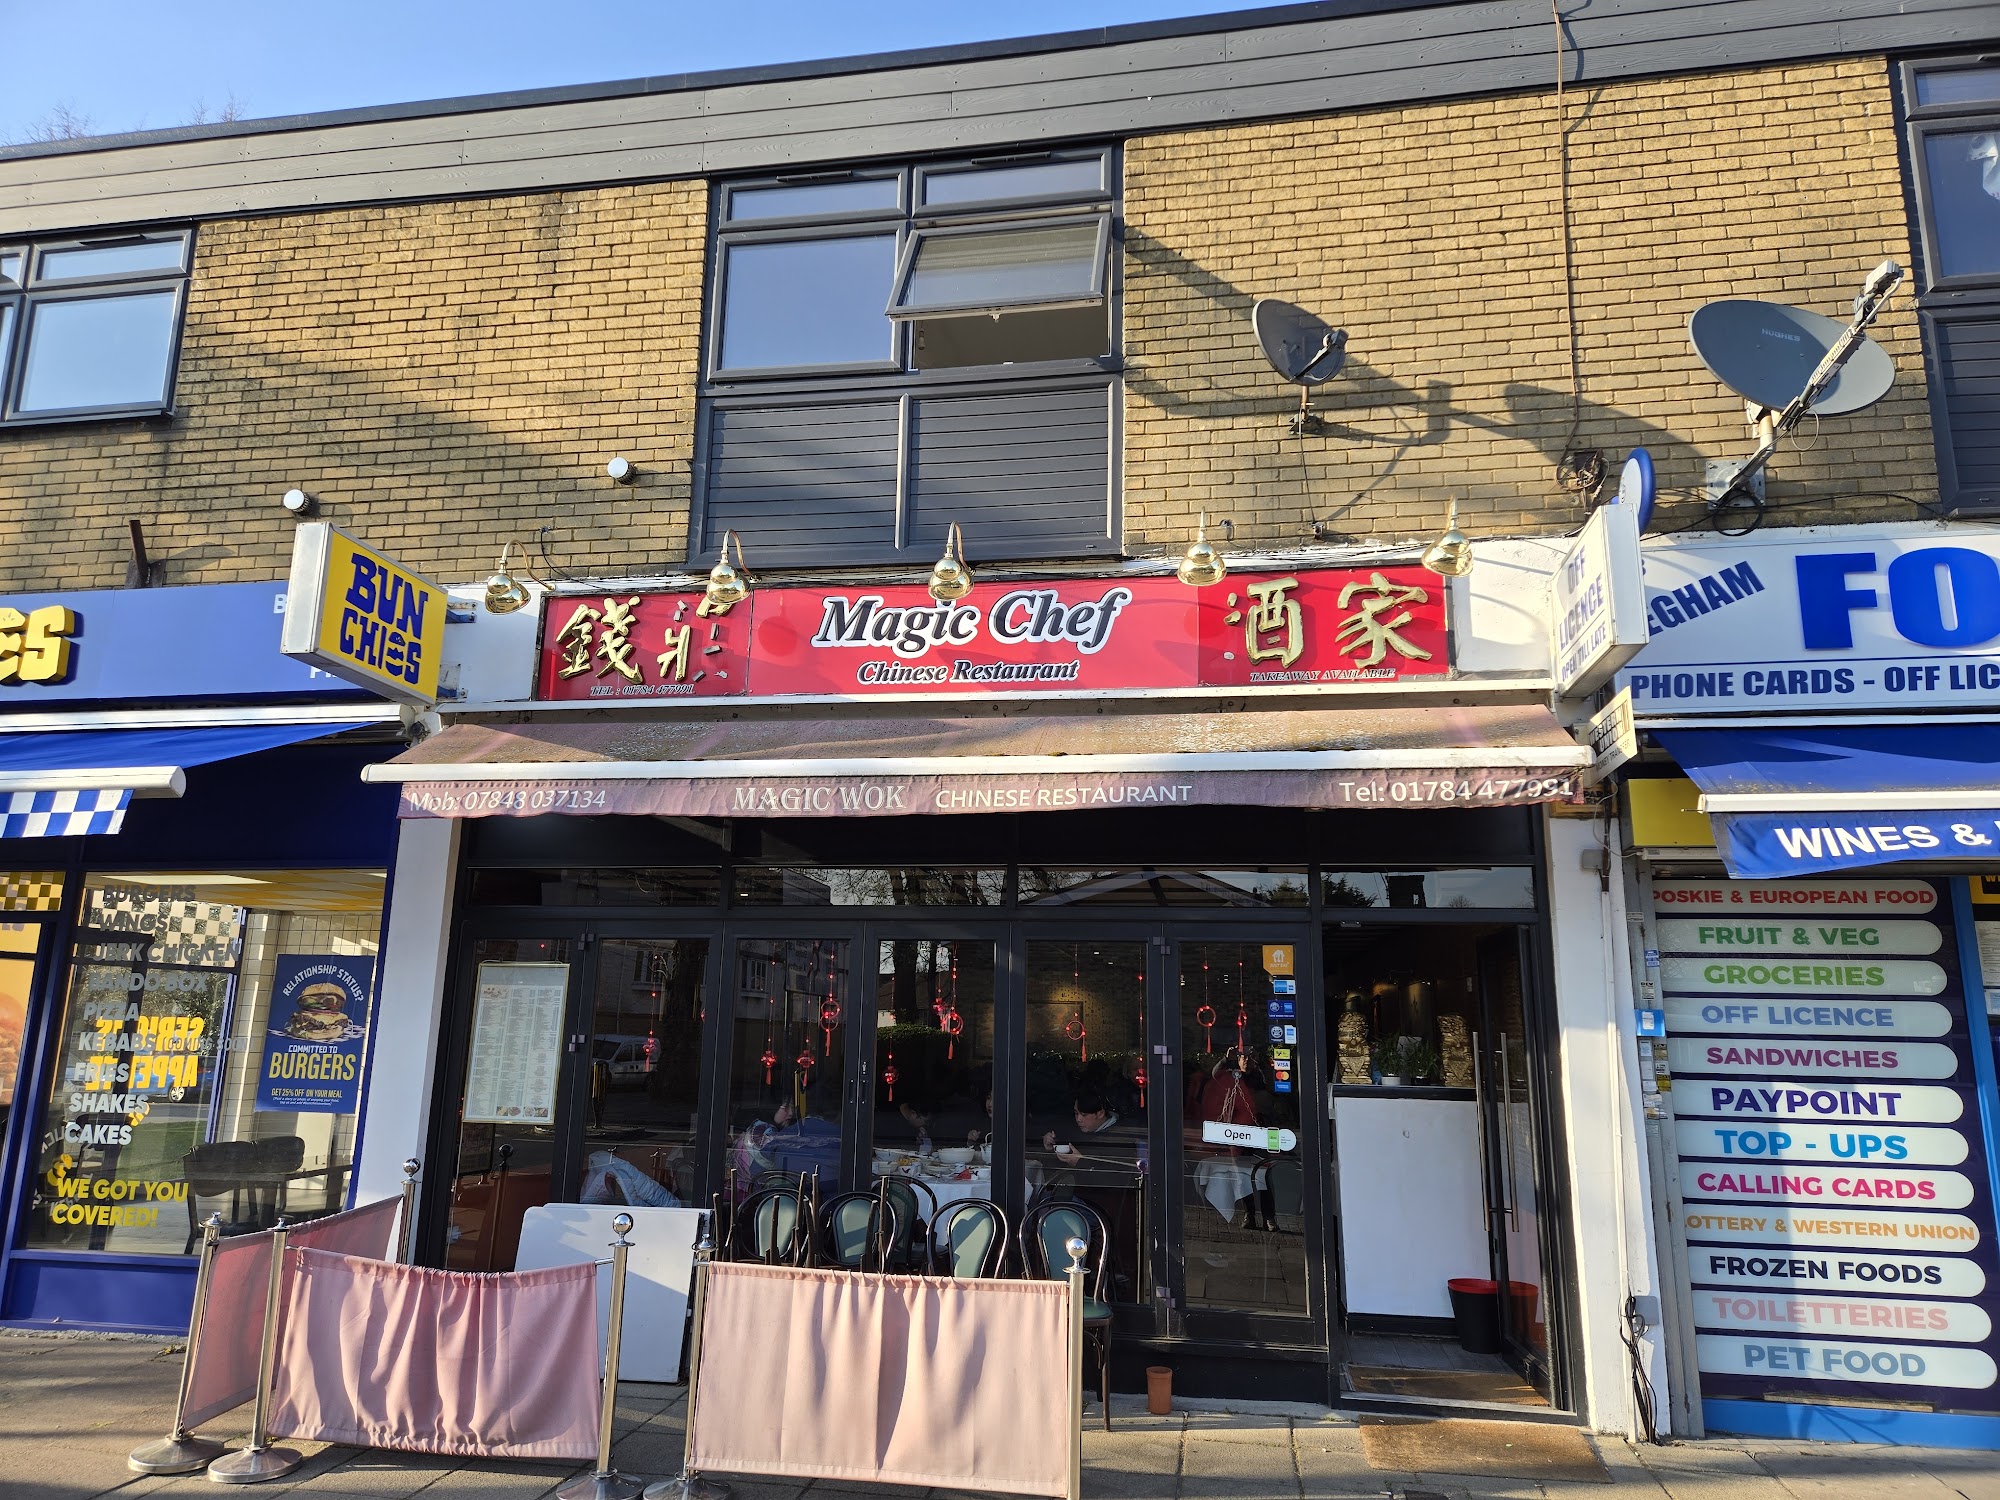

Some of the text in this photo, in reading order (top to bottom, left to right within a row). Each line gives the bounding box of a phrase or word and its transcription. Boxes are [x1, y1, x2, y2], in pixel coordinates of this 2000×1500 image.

[1762, 328, 1801, 342] HUGHES
[1567, 545, 1586, 594] OFF
[345, 552, 429, 640] BUN
[1795, 547, 2000, 649] FO
[813, 590, 1130, 655] Magic Chef
[1559, 572, 1604, 651] LICENCE
[1561, 621, 1606, 682] OPEN TILL LATE
[857, 659, 1080, 685] Chinese Restaurant
[1250, 668, 1397, 682] TAKEAWAY AVAILABLE
[1631, 671, 1733, 699] PHONE
[1743, 668, 1856, 697] CARDS
[1884, 666, 1940, 692] OFF
[590, 686, 614, 696] TEL
[622, 685, 655, 696] 01784
[1600, 722, 1622, 752] UNION
[411, 790, 606, 811] Mob: 07848 037134
[732, 781, 906, 812] MAGIC WOK
[935, 786, 1192, 808] CHINESE RESTAURANT
[1339, 782, 1384, 802] Tel:
[1391, 781, 1472, 801] 01784
[1478, 778, 1574, 799] 477991
[1774, 823, 1993, 858] WINES &
[102, 884, 197, 902] BURGERS
[1730, 890, 1743, 904] &
[1750, 890, 1868, 904] EUROPEAN
[1875, 890, 1934, 904] FOOD
[100, 911, 168, 932] WINGS
[1699, 926, 1880, 946] FRUIT & VEG
[92, 943, 240, 962] JERK CHICKEN
[88, 973, 210, 992] BANDO BOX
[283, 964, 364, 1002] RELATIONSHIP STATUS?
[1704, 965, 1885, 987] GROCERIES
[83, 1002, 140, 1022] PIZZA
[1701, 1005, 1895, 1027] OFF LICENCE
[78, 1031, 157, 1052] KEBABS
[288, 1044, 338, 1054] COMMITTED TO
[269, 1052, 356, 1081] BURGERS
[1706, 1047, 1899, 1069] SANDWICHES
[74, 1062, 130, 1083] FRIES
[68, 1092, 149, 1114] SHAKES
[271, 1088, 343, 1098] GET 25% OFF ON YOUR MEAL
[1712, 1088, 1901, 1116] PAYPOINT
[64, 1123, 133, 1145] CAKES
[1224, 1129, 1252, 1140] Open
[1715, 1129, 1792, 1155] TOP
[1830, 1133, 1908, 1160] UPS
[57, 1178, 189, 1203] WE GOT YOU
[1697, 1172, 1936, 1200] CALLING CARDS
[52, 1203, 159, 1228] COVERED!
[1685, 1215, 1975, 1241] OTTERY & WESTERN UNION
[1710, 1256, 1943, 1286] FROZEN FOODS
[1711, 1297, 1949, 1331] TOILETTERIES
[1744, 1344, 1927, 1378] PET FOOD
